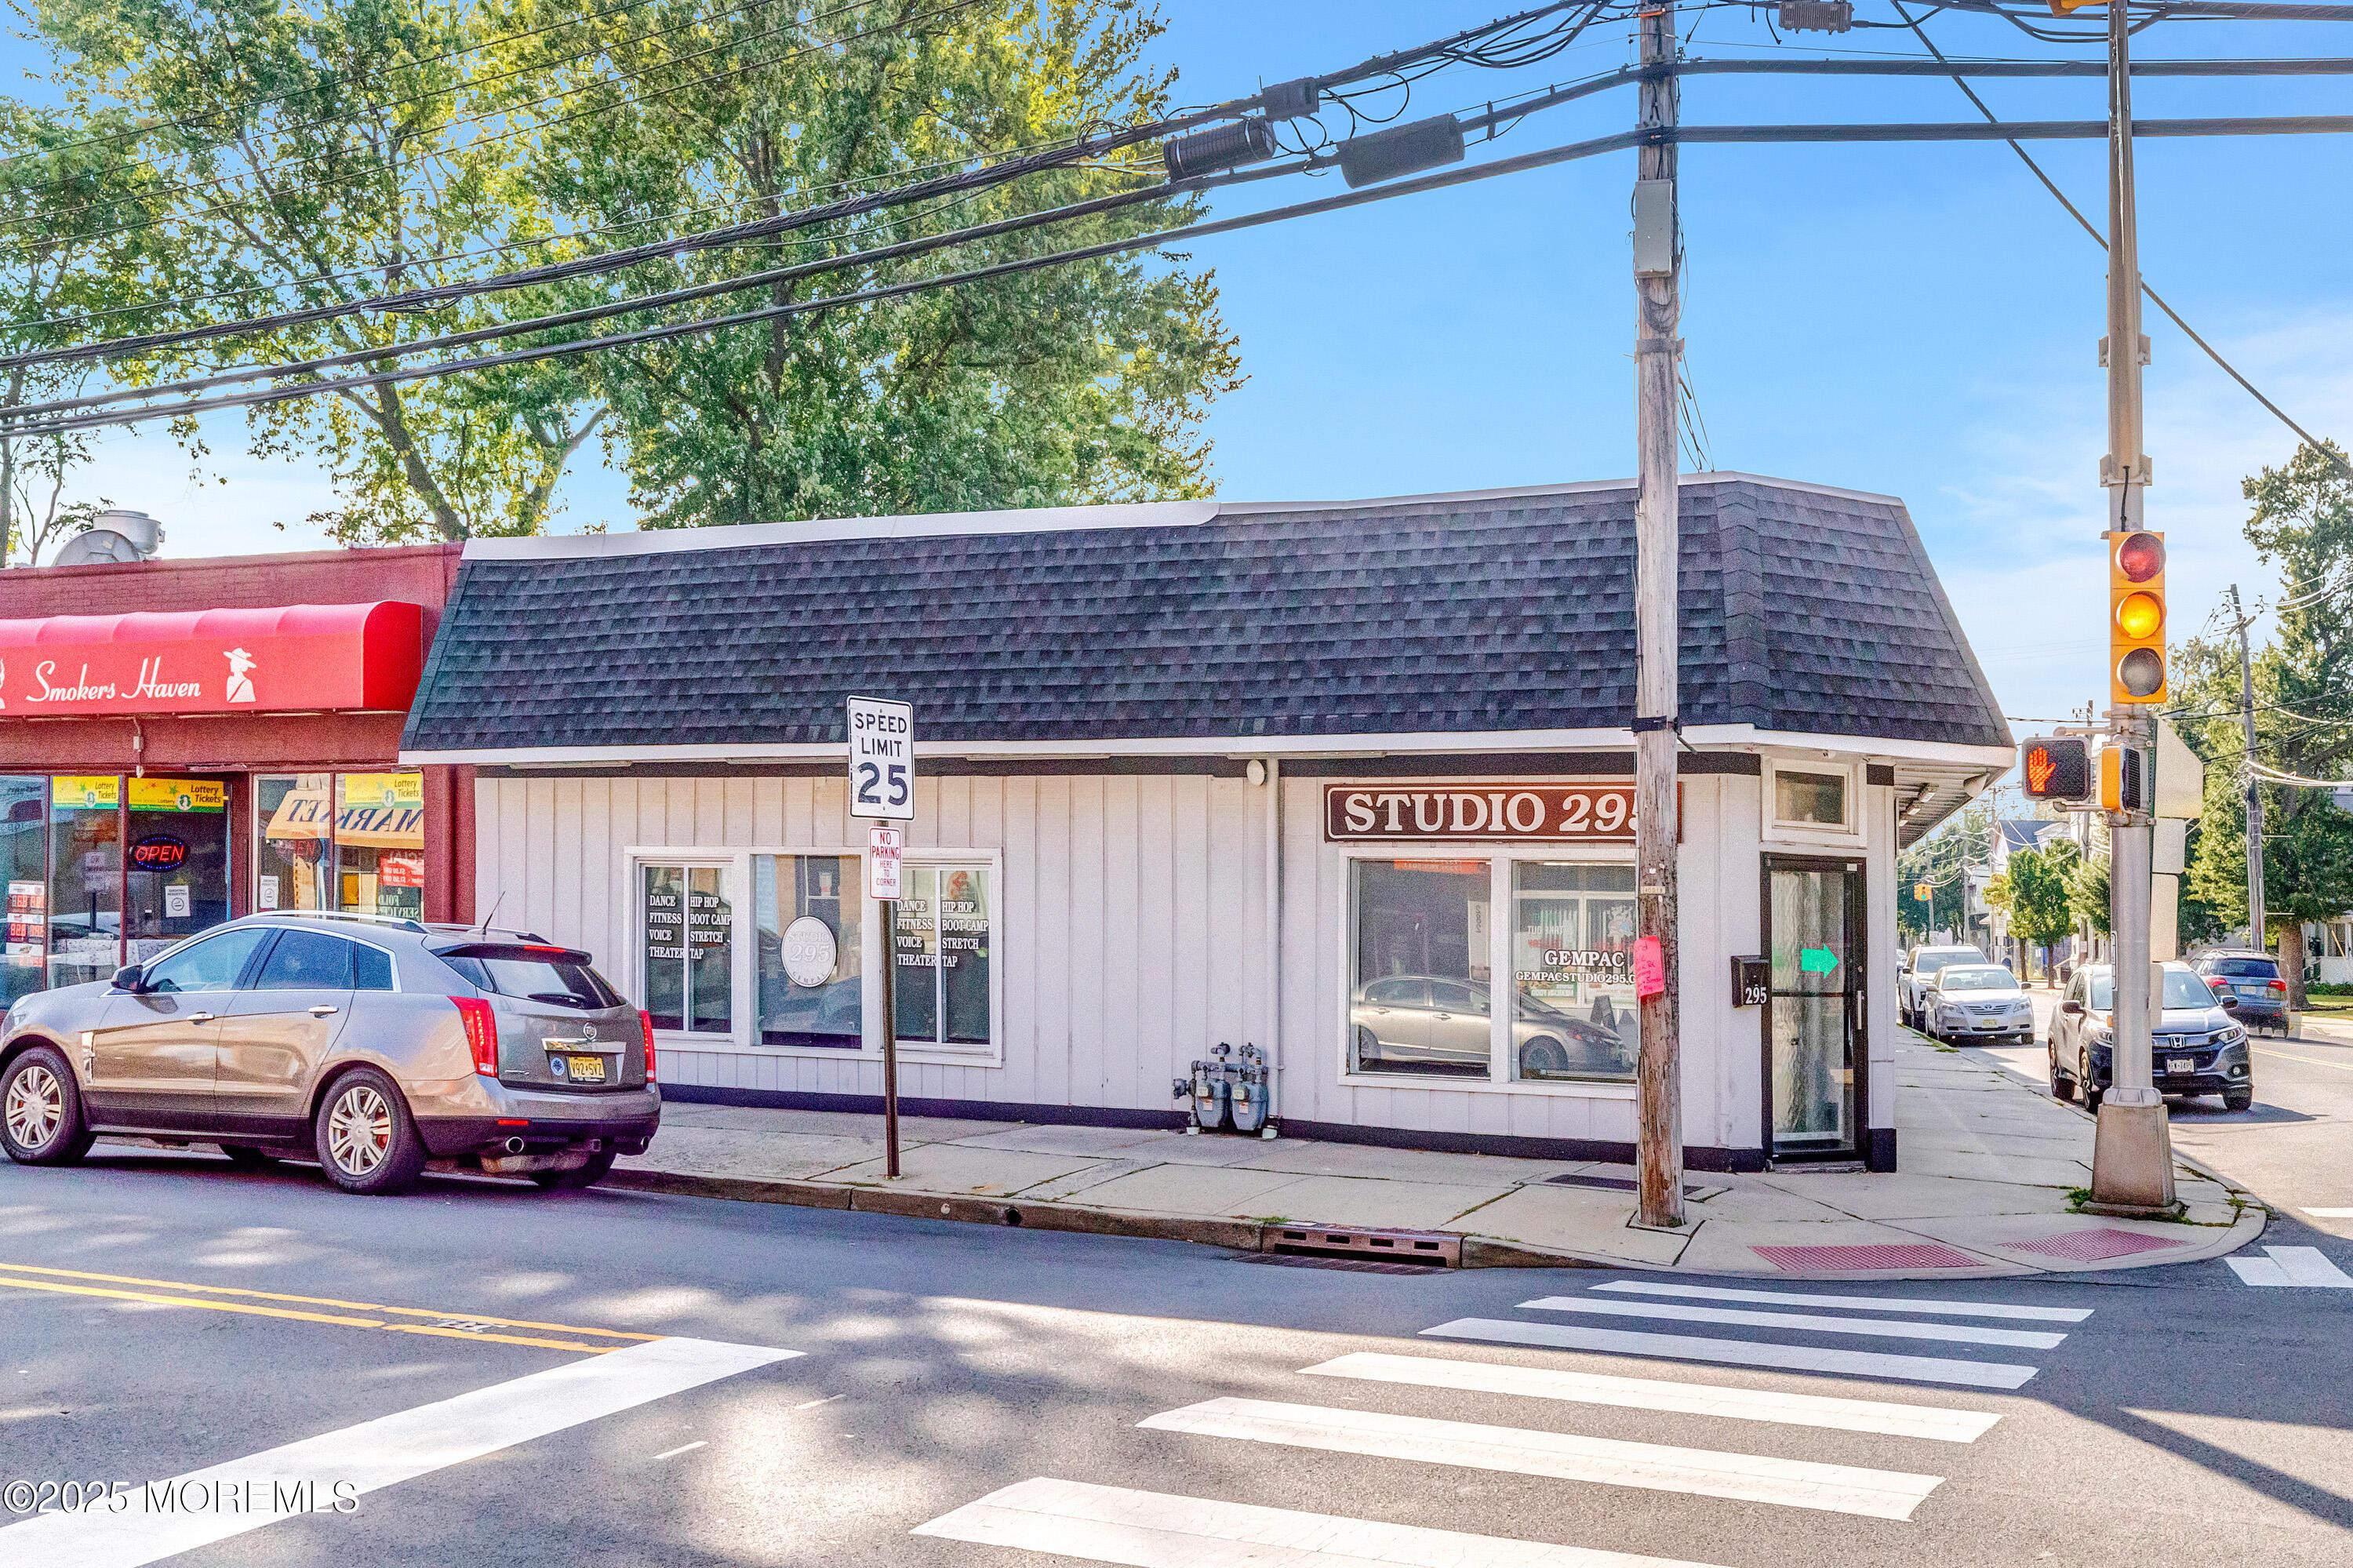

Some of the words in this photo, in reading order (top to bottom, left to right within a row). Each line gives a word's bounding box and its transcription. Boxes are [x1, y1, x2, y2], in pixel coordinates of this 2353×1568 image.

[26, 660, 115, 702] Smokers
[121, 656, 202, 699] Haven
[855, 712, 907, 733] SPEED
[861, 737, 902, 757] LIMIT
[95, 782, 115, 791] Lottery
[394, 779, 417, 789] Lottery
[858, 762, 908, 806] 25
[98, 791, 117, 799] Tickets
[191, 785, 219, 796] Lottery
[398, 789, 419, 798] Tickets
[195, 795, 221, 803] Tickets
[1344, 792, 1546, 832] STUDIO
[879, 832, 892, 845] NO
[136, 846, 184, 862] OPEN
[872, 846, 900, 860] PARKING
[876, 878, 896, 886] CORNER
[649, 895, 675, 907] DANCE
[690, 896, 703, 908] HIP
[704, 897, 719, 908] HOP
[896, 900, 926, 911] DANCE
[942, 900, 956, 913] HIP
[957, 901, 974, 913] HOP
[649, 912, 682, 924] FITNESS
[690, 913, 711, 925] BOOT
[711, 914, 732, 926] CAMP
[896, 918, 933, 930] FITNESS
[942, 919, 964, 931] BOOT
[966, 919, 988, 932] CAMP
[649, 929, 673, 941] VOICE
[690, 930, 723, 943] STRETCH
[896, 936, 922, 948] VOICE
[942, 937, 980, 949] STRETCH
[649, 946, 684, 959] THEATER
[690, 948, 704, 959] TAP
[790, 944, 831, 962] 295
[1544, 950, 1625, 966] GEMPAC
[896, 954, 936, 966] THEATER
[942, 955, 958, 967] TAP
[1745, 986, 1767, 1004] 295
